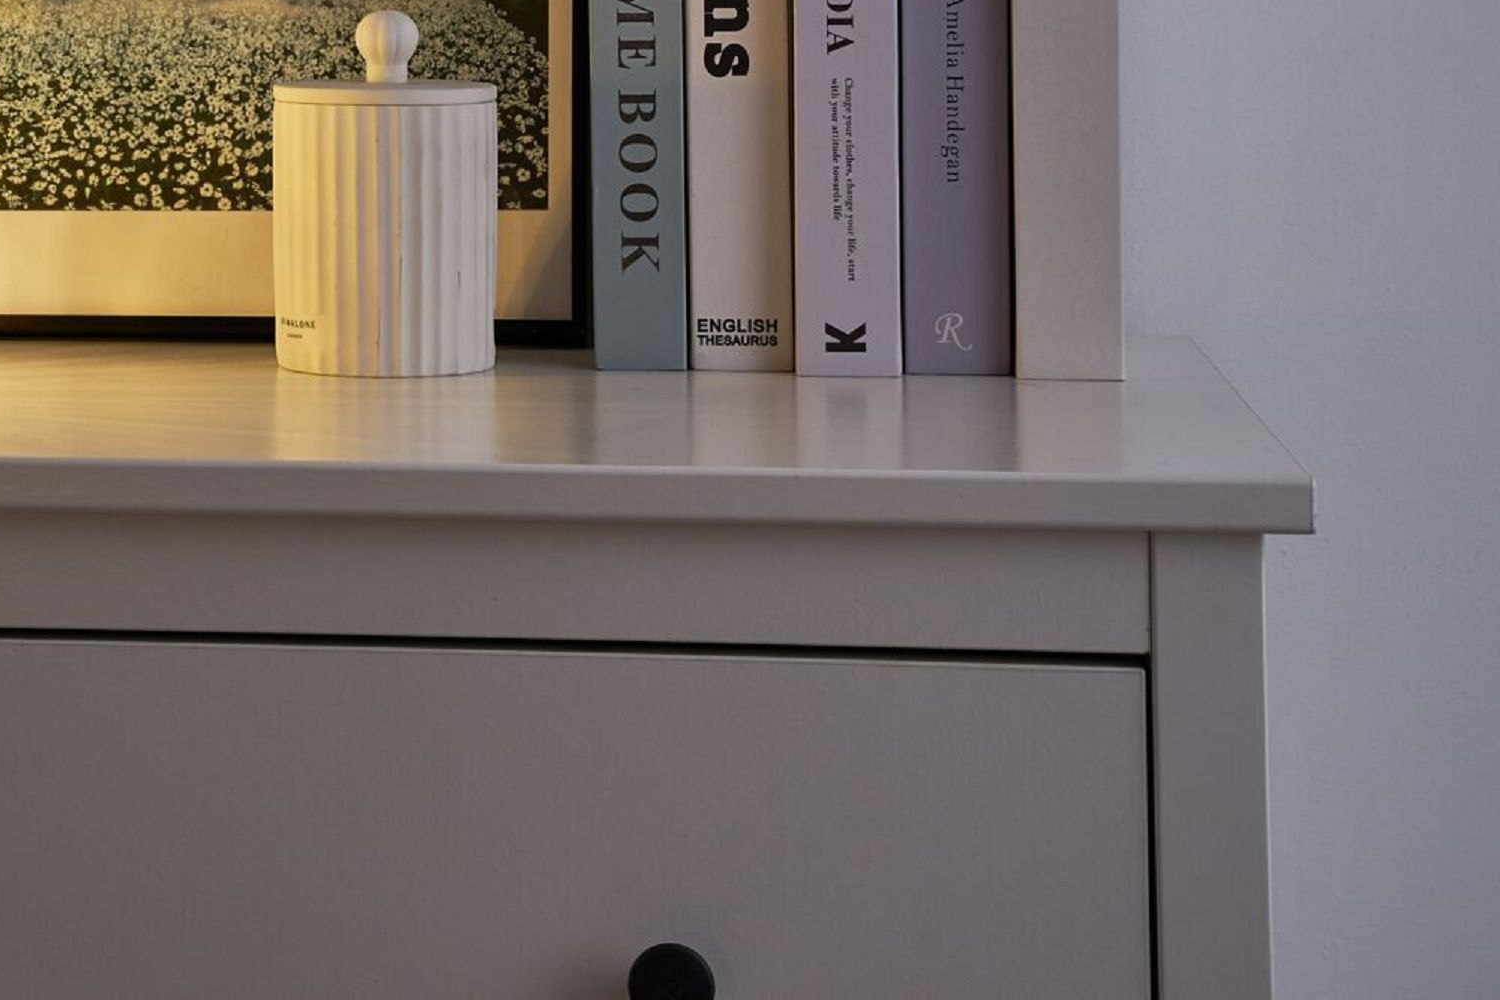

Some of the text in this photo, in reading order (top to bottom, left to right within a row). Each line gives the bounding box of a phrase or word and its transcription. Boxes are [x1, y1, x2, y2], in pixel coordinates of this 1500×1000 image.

[842, 77, 854, 112] Change
[842, 114, 853, 137] your
[939, 74, 967, 183] Handegan
[828, 77, 843, 221] with your attitude towards life
[617, 88, 660, 273] BOOK
[843, 178, 855, 212] change
[844, 213, 855, 235] your
[847, 259, 856, 282] start
[696, 317, 779, 334] ENGLISH
[696, 334, 779, 347] THESAURUS
[824, 321, 867, 353] K
